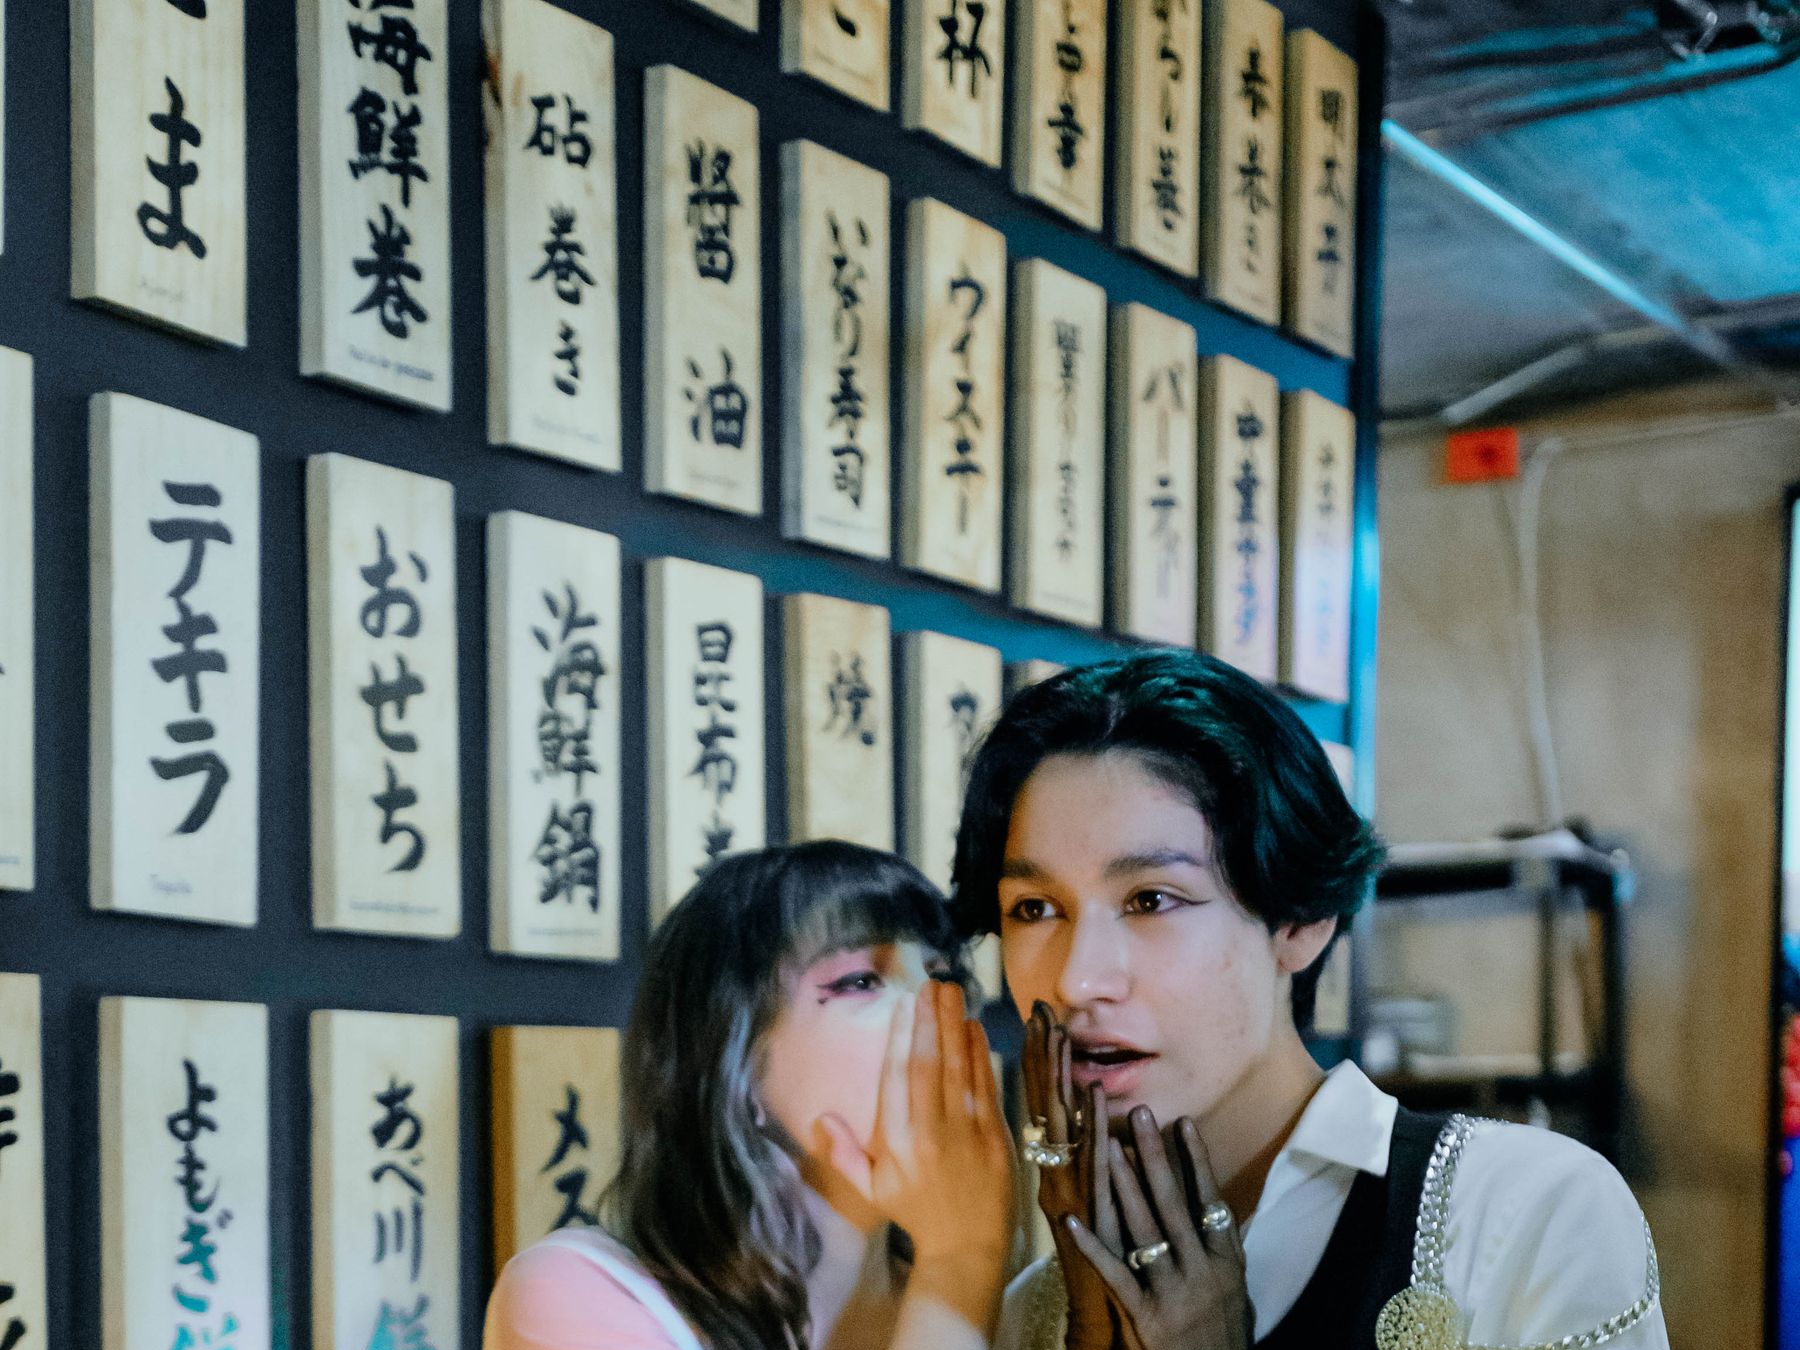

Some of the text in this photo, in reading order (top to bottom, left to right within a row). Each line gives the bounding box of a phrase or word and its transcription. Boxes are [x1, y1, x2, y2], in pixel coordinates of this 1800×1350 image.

[148, 480, 233, 836] テキラ
[359, 525, 429, 873] おせち
